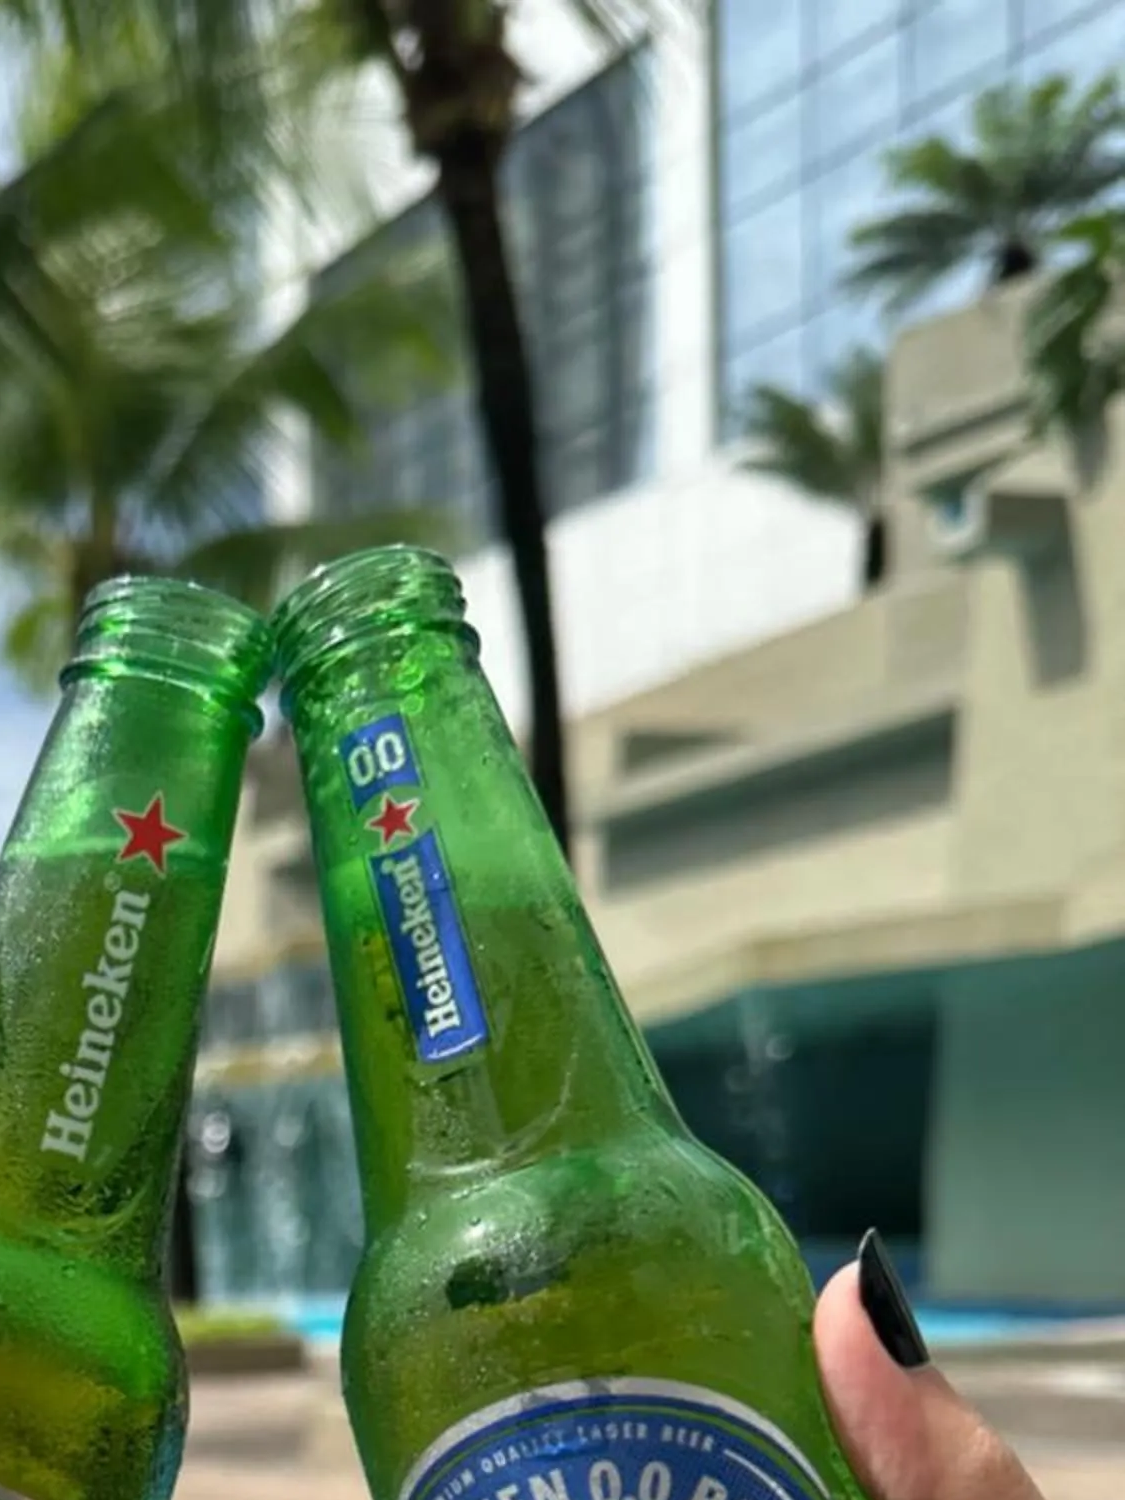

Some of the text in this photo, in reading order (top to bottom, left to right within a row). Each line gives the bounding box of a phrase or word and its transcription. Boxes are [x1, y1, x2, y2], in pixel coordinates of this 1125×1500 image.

[347, 731, 406, 787] 0.0
[393, 852, 462, 1038] Heineken
[40, 889, 151, 1163] Heineken
[577, 1421, 648, 1445] LAGER
